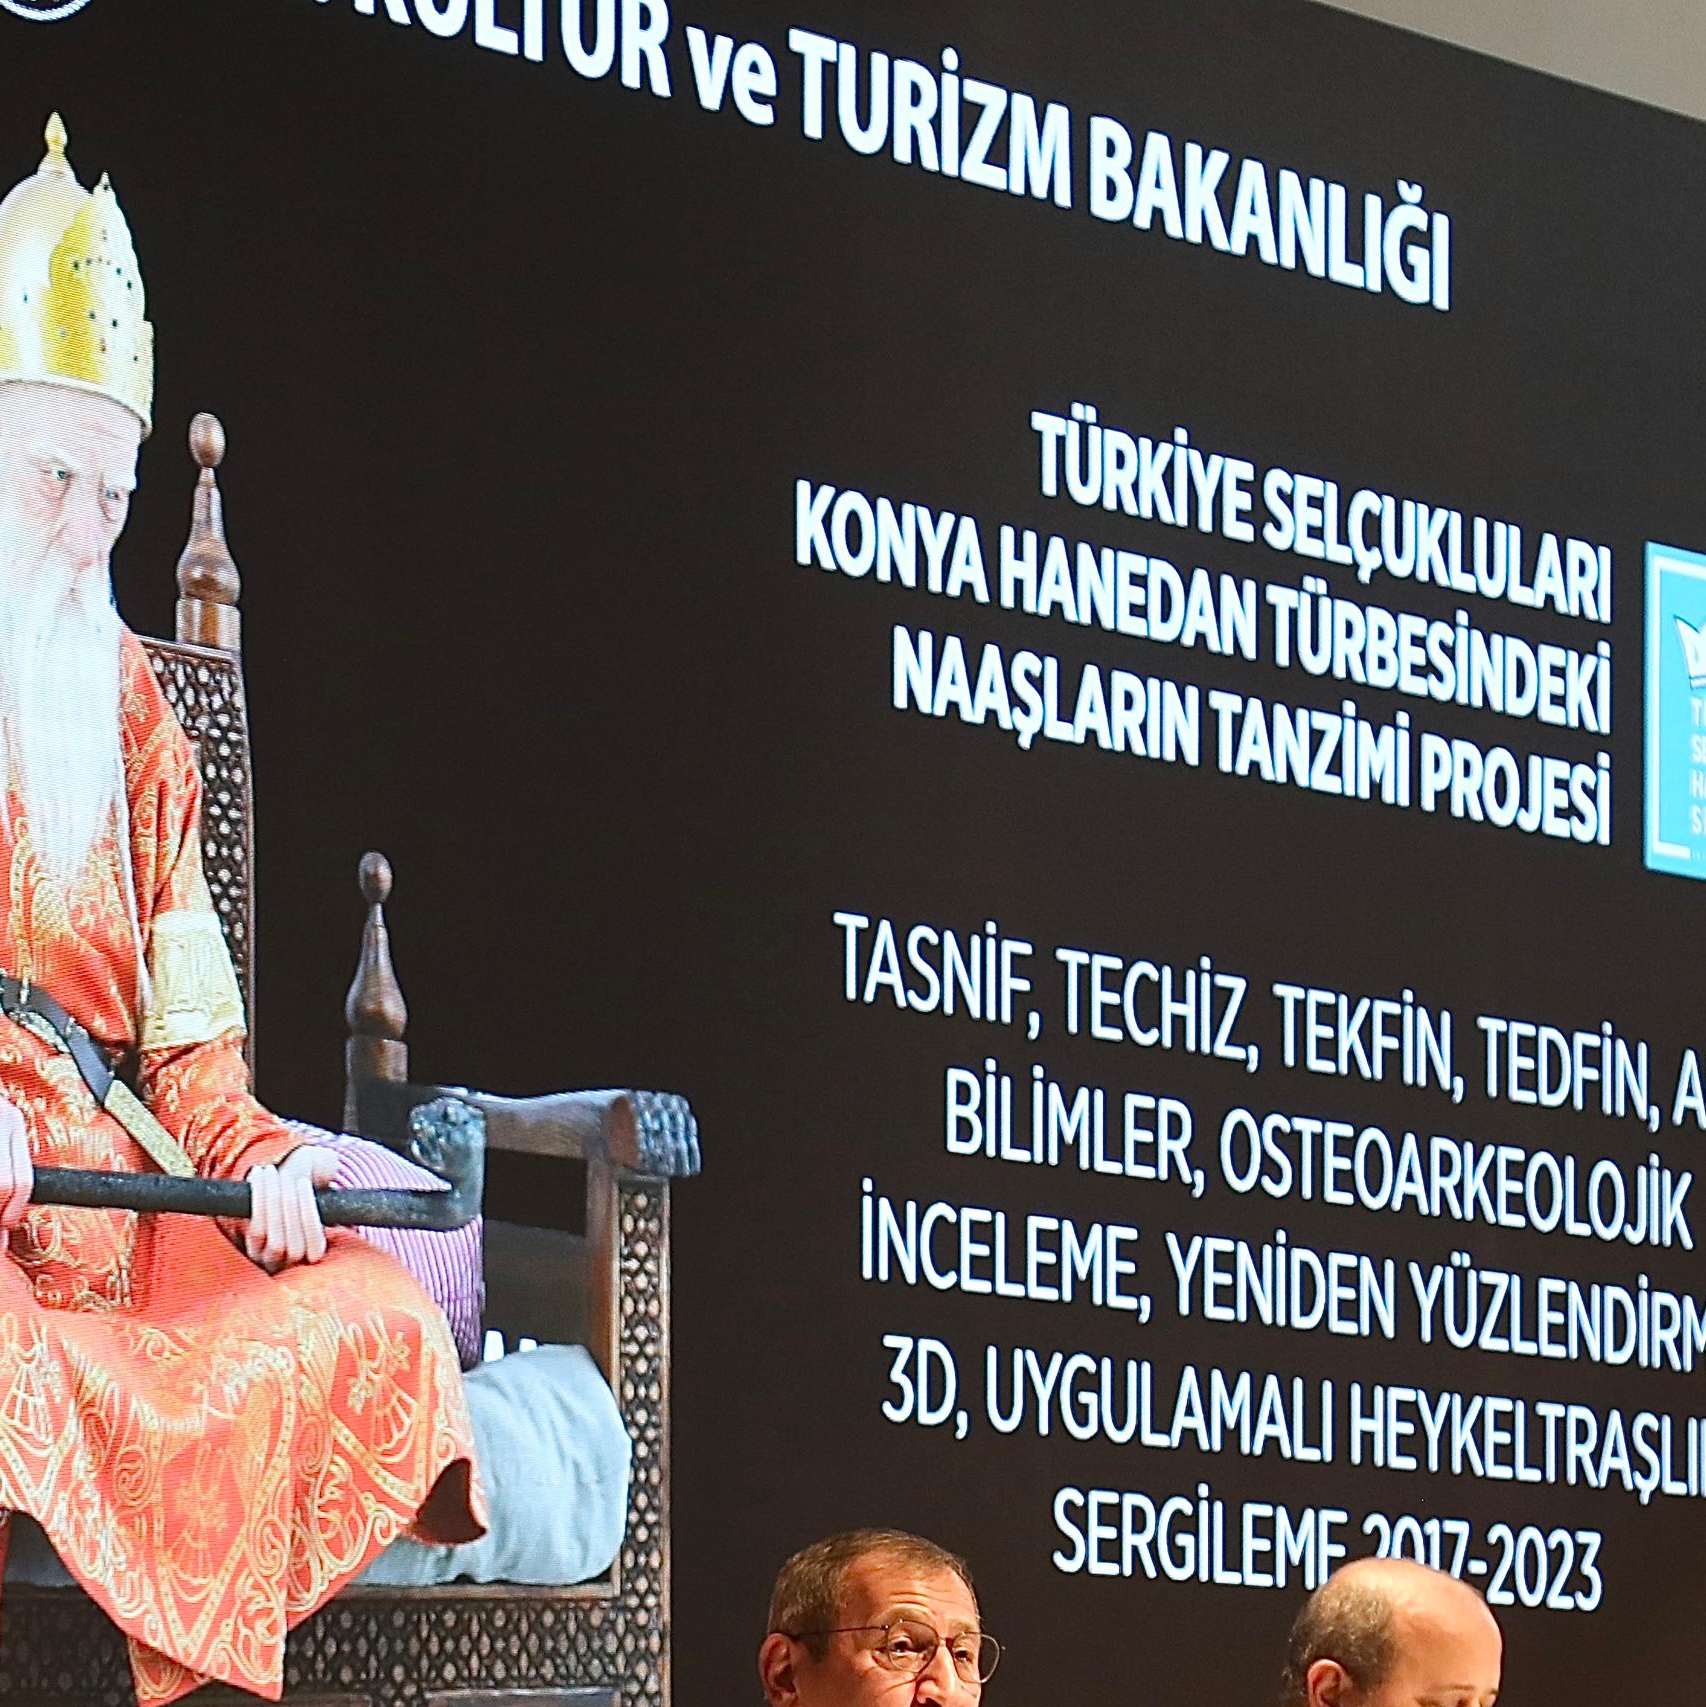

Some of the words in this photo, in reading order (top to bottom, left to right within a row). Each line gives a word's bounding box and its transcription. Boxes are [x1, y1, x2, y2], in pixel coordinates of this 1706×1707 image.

[353, 0, 673, 98] LÜR
[684, 26, 778, 126] ve
[787, 28, 1073, 209] TURİZM
[1088, 115, 1451, 311] BAKANLIĞI
[796, 479, 990, 604] KONYA
[1000, 524, 1257, 661] HANEDAN
[1265, 575, 1611, 735] TÜRBESİNDEKİ
[1031, 401, 1255, 543] TÜRKİYE
[1262, 468, 1611, 624] SELÇUKLULARI
[893, 625, 1200, 766] NAAŞLARIN
[1208, 689, 1410, 807] TANZİMİ
[1420, 732, 1611, 846] PROJESİ
[833, 911, 1040, 1040] TASNİF,
[1055, 948, 1259, 1073] TECHİZ,
[1272, 983, 1464, 1104] TEKFİN,
[1476, 1016, 1660, 1133] TEDFİN,
[862, 1177, 1151, 1324] İNCELEME,
[1165, 1229, 1395, 1339] YENİDEN
[946, 1057, 1205, 1199] BİLİMLER,
[1220, 1108, 1694, 1250] OSTEOARKEOLOJİK
[881, 1334, 968, 1440] 3D,
[986, 1345, 1333, 1463] UYGULAMALI
[1052, 1482, 1348, 1591] SERGİLEME
